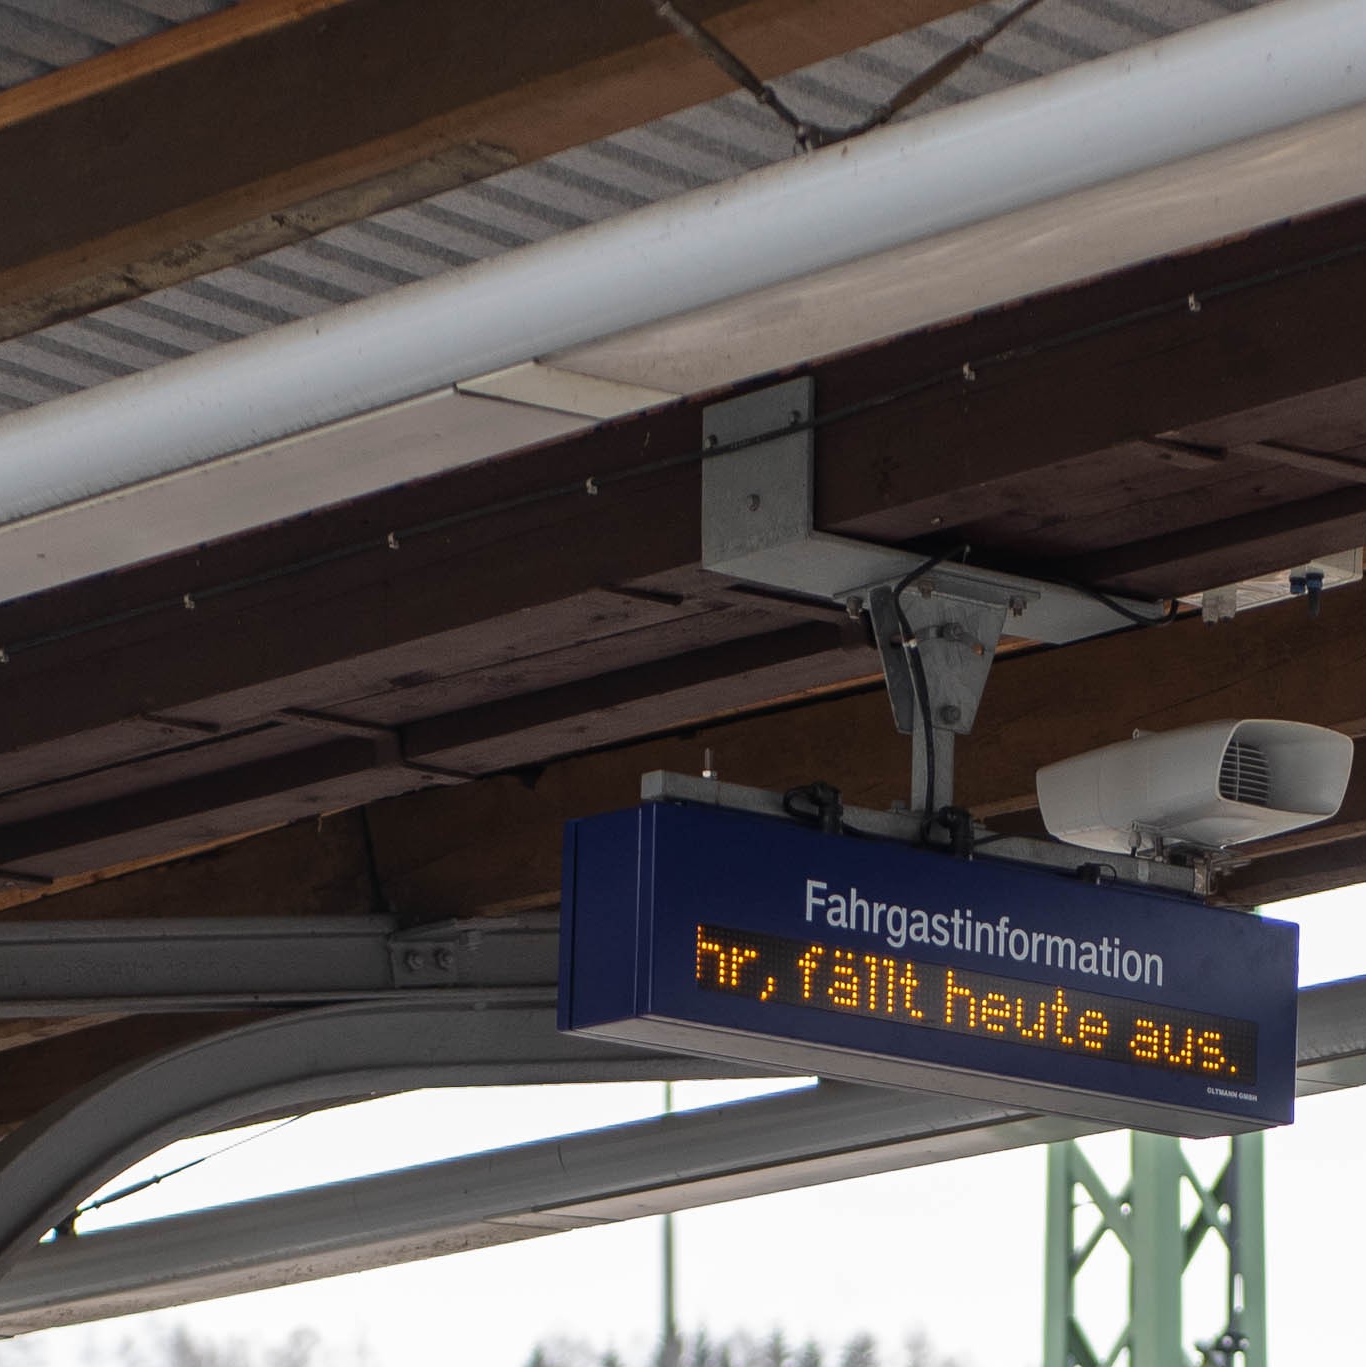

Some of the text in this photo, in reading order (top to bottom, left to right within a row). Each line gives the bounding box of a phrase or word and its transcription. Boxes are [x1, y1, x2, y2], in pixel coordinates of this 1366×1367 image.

[805, 879, 1163, 987] Fahrgastinformation
[797, 945, 924, 1020] fällt
[944, 968, 1110, 1049] heute
[1129, 1016, 1241, 1075] aus.
